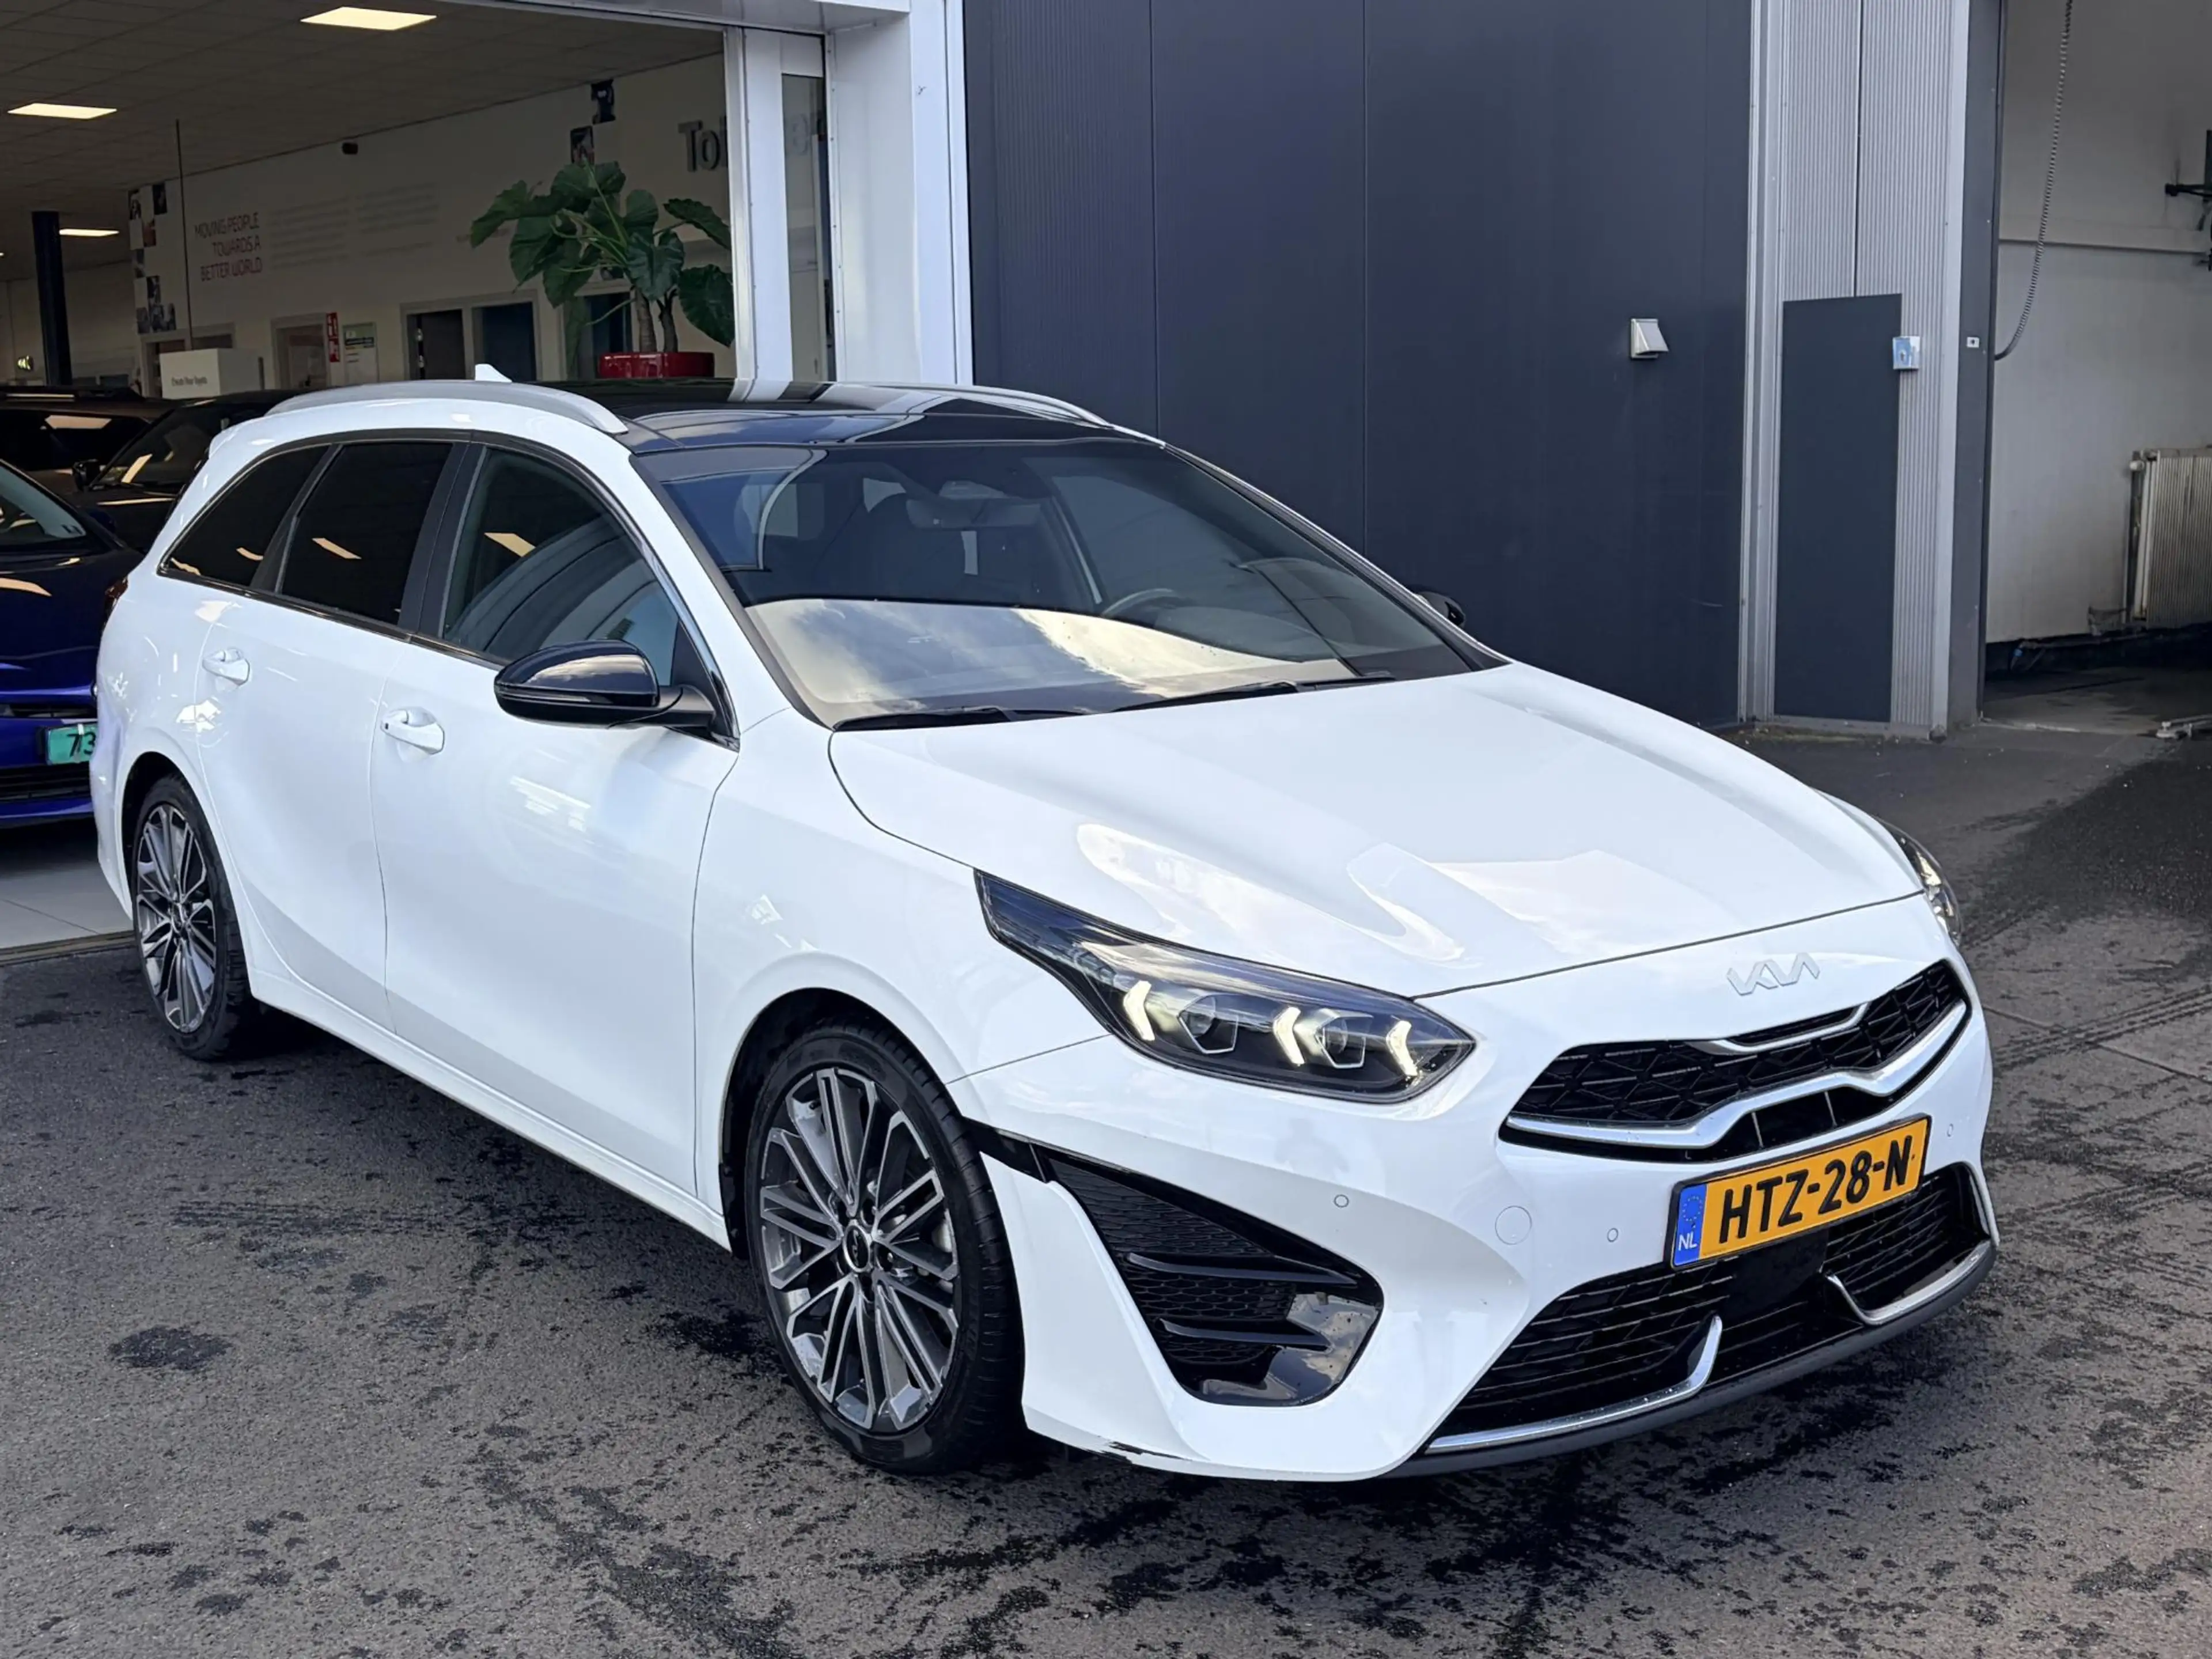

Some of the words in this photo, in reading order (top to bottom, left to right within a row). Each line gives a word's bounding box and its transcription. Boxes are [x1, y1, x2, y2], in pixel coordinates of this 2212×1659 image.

[228, 211, 260, 232] PEOPLE
[212, 236, 253, 257] TOWARDS
[200, 262, 229, 282] BETTER
[231, 256, 263, 276] WORLD
[1726, 952, 1821, 997] KIA
[1719, 1135, 1913, 1244] HTZ-28-N
[1677, 1229, 1698, 1252] NL
